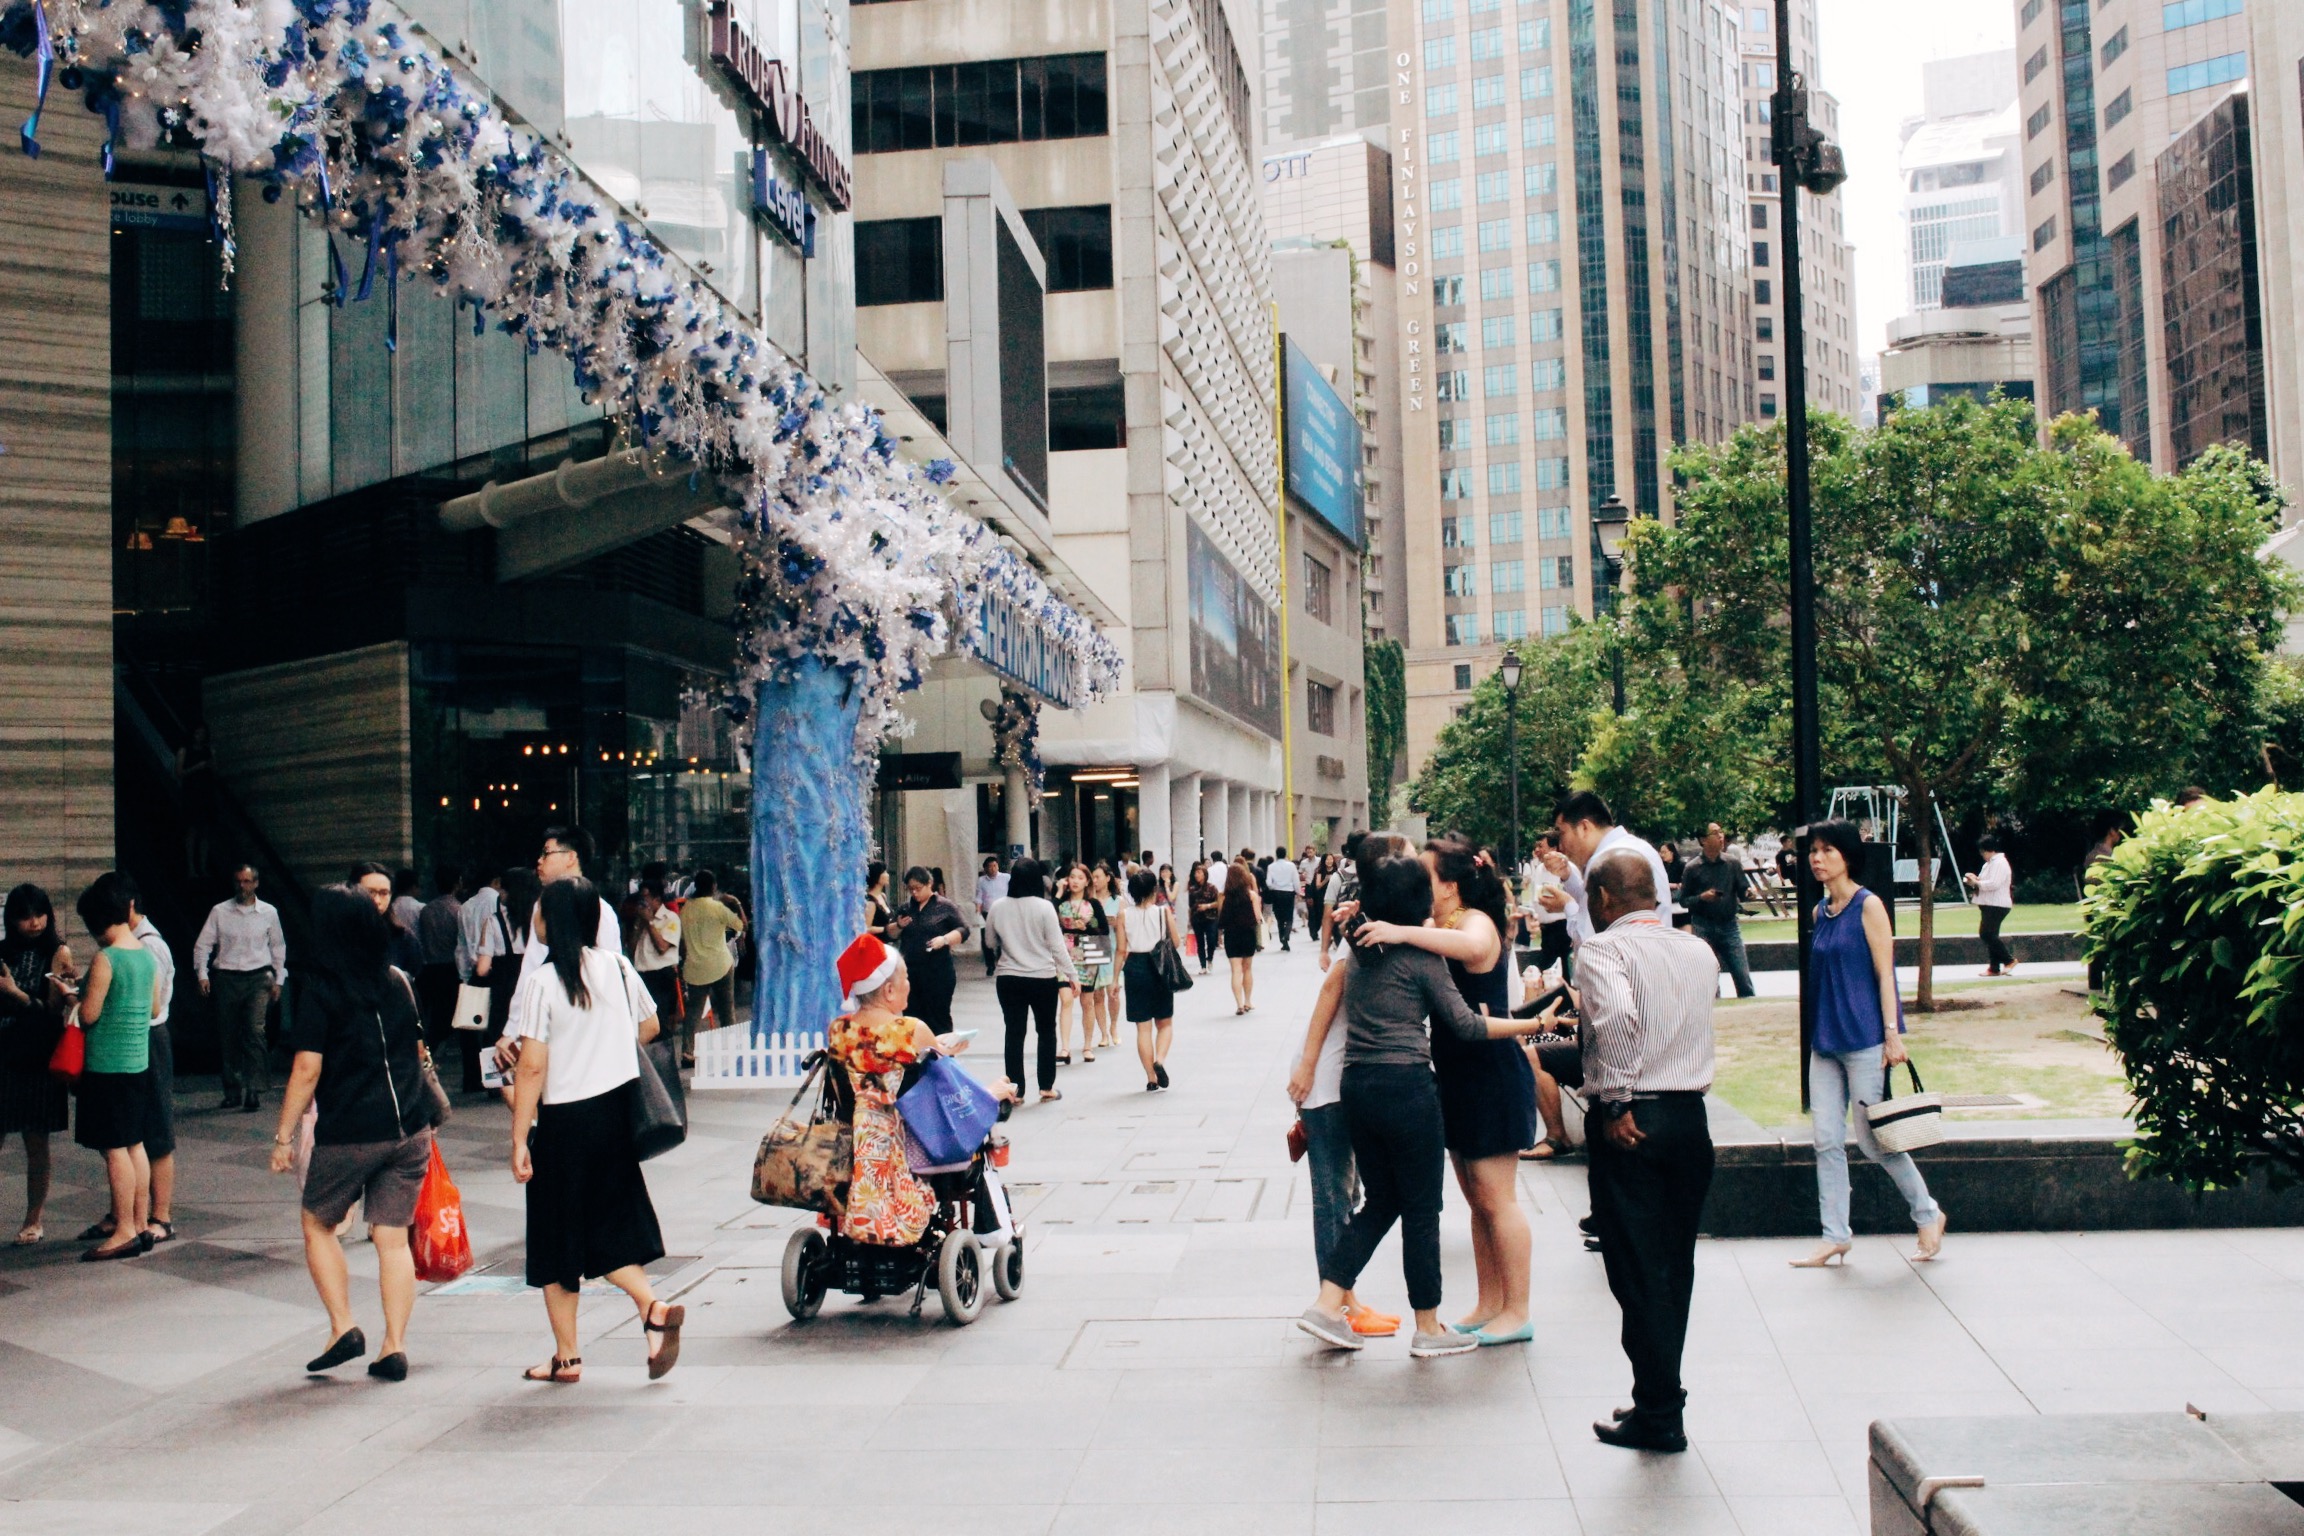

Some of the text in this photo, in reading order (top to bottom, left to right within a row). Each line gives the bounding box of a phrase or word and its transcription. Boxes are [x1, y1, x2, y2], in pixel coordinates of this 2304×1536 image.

[721, 0, 850, 213] TRUE FITNESS
[125, 211, 159, 225] lobby
[763, 150, 805, 246] Level
[1397, 52, 1423, 412] ONE FINLAYSON GREEN
[1044, 637, 1075, 707] HOUS
